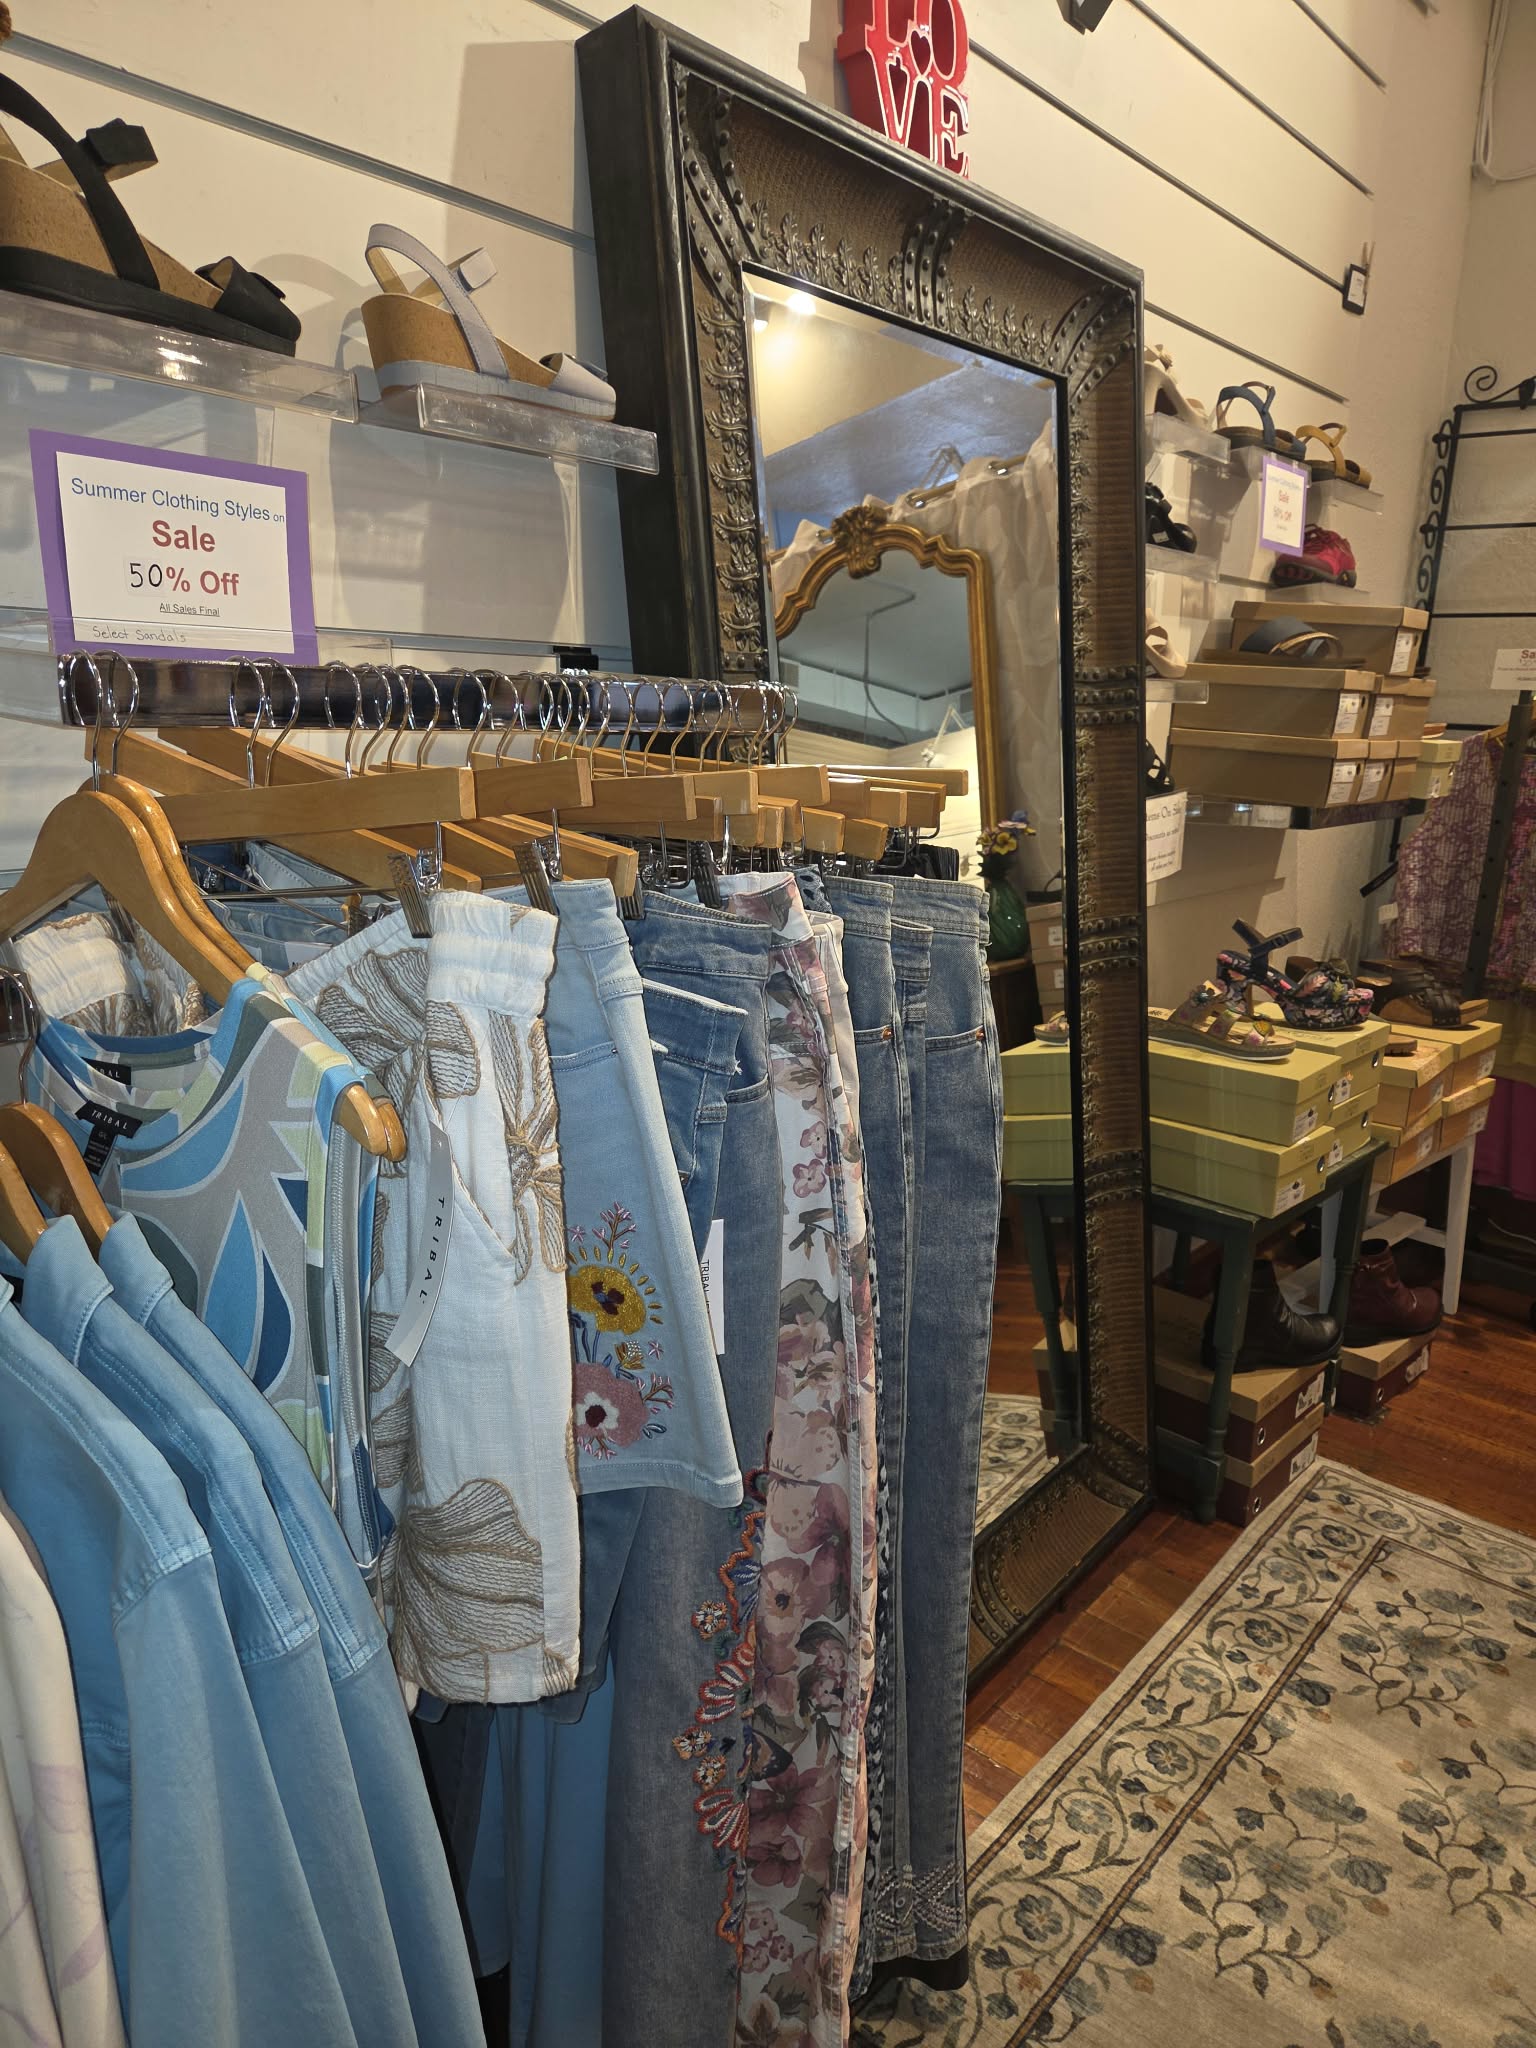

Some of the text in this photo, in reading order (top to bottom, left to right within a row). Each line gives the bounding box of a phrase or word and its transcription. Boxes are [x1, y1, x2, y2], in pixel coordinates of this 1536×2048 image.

[71, 477, 285, 522] Summer Clothing Styles on
[152, 519, 215, 552] Sale
[130, 563, 240, 596] 50% Off
[160, 603, 220, 616] All Sales Final
[93, 625, 187, 643] Select Sandals
[92, 1109, 128, 1130] TRIBAL
[419, 1197, 445, 1300] TRIBAL
